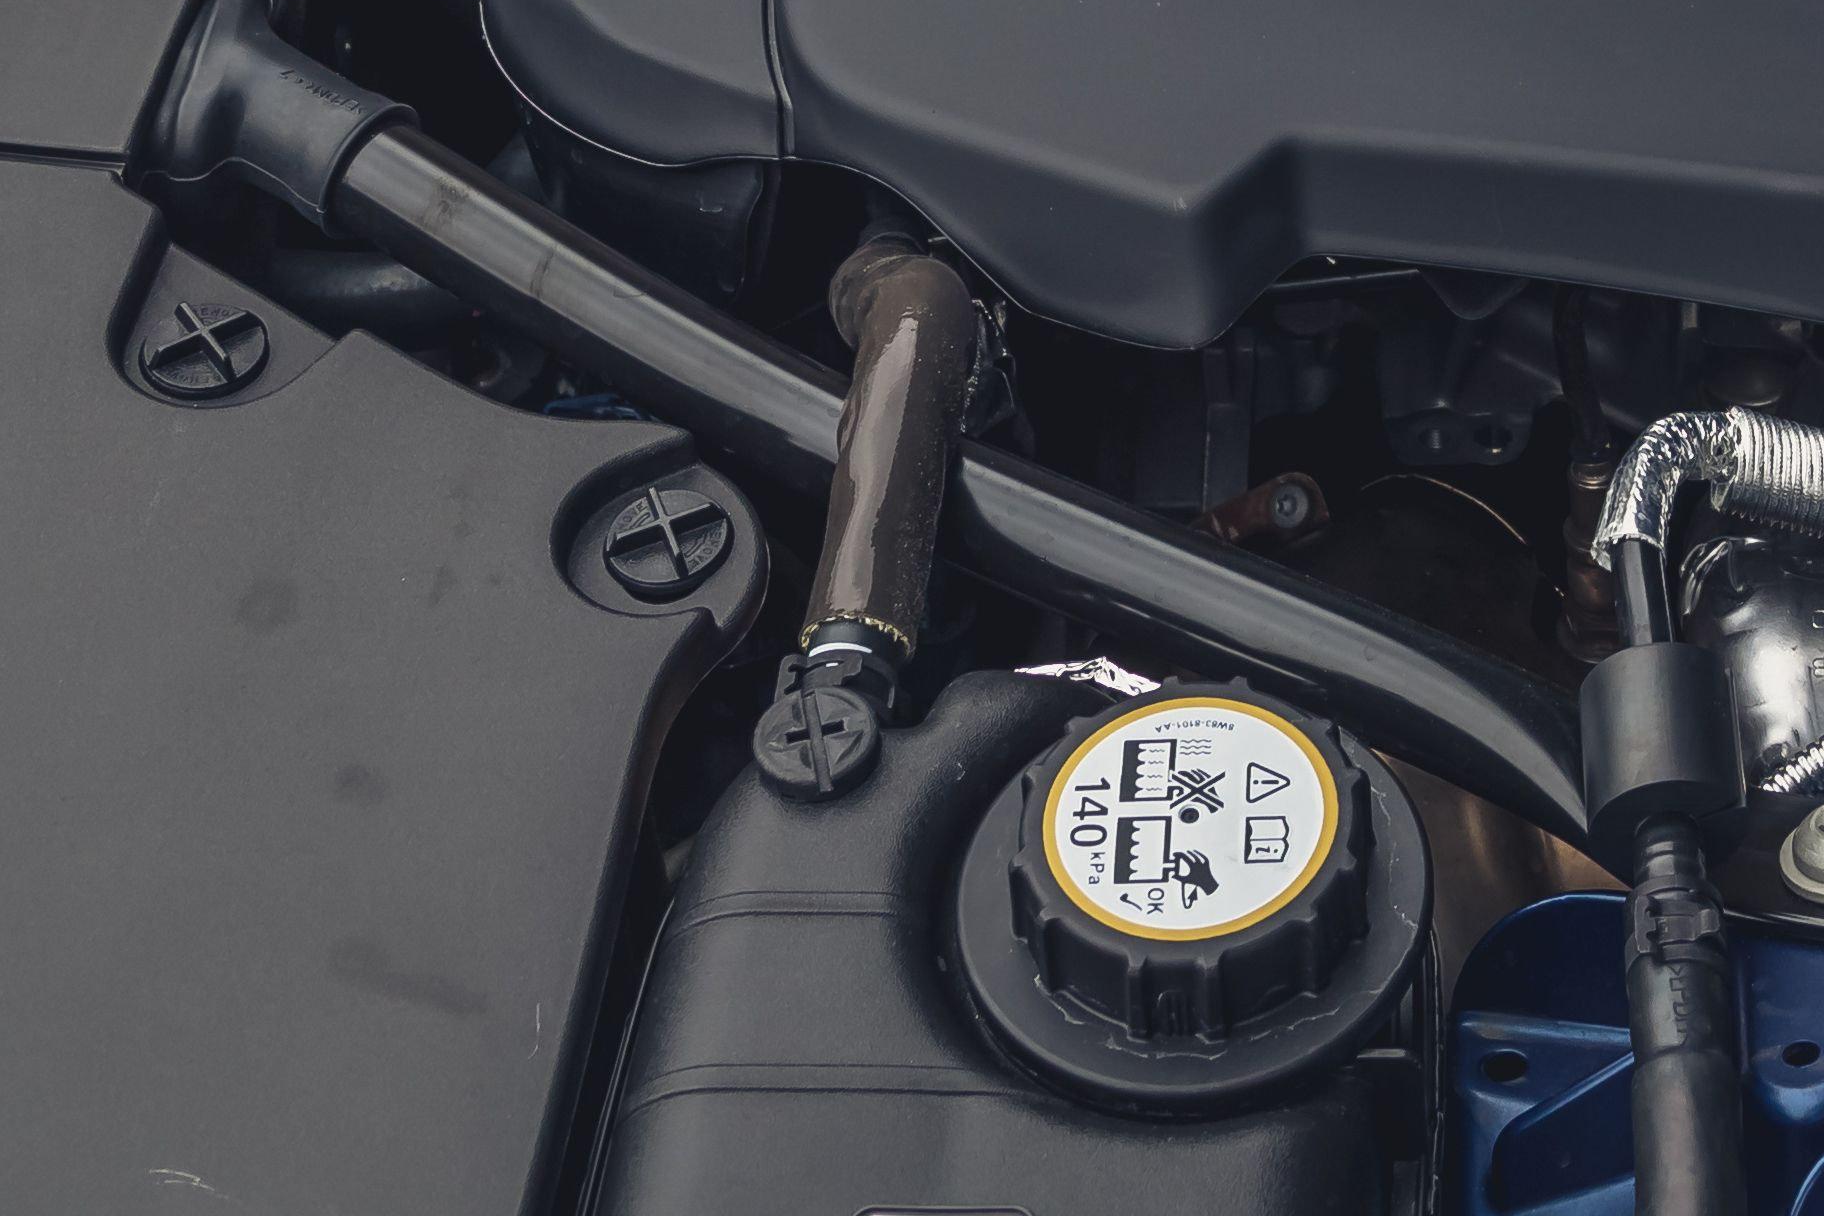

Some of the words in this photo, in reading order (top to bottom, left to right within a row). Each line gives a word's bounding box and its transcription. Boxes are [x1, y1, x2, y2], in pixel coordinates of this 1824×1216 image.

[1069, 776, 1112, 848] 140
[1088, 851, 1106, 886] kPa
[1146, 887, 1165, 915] OK
